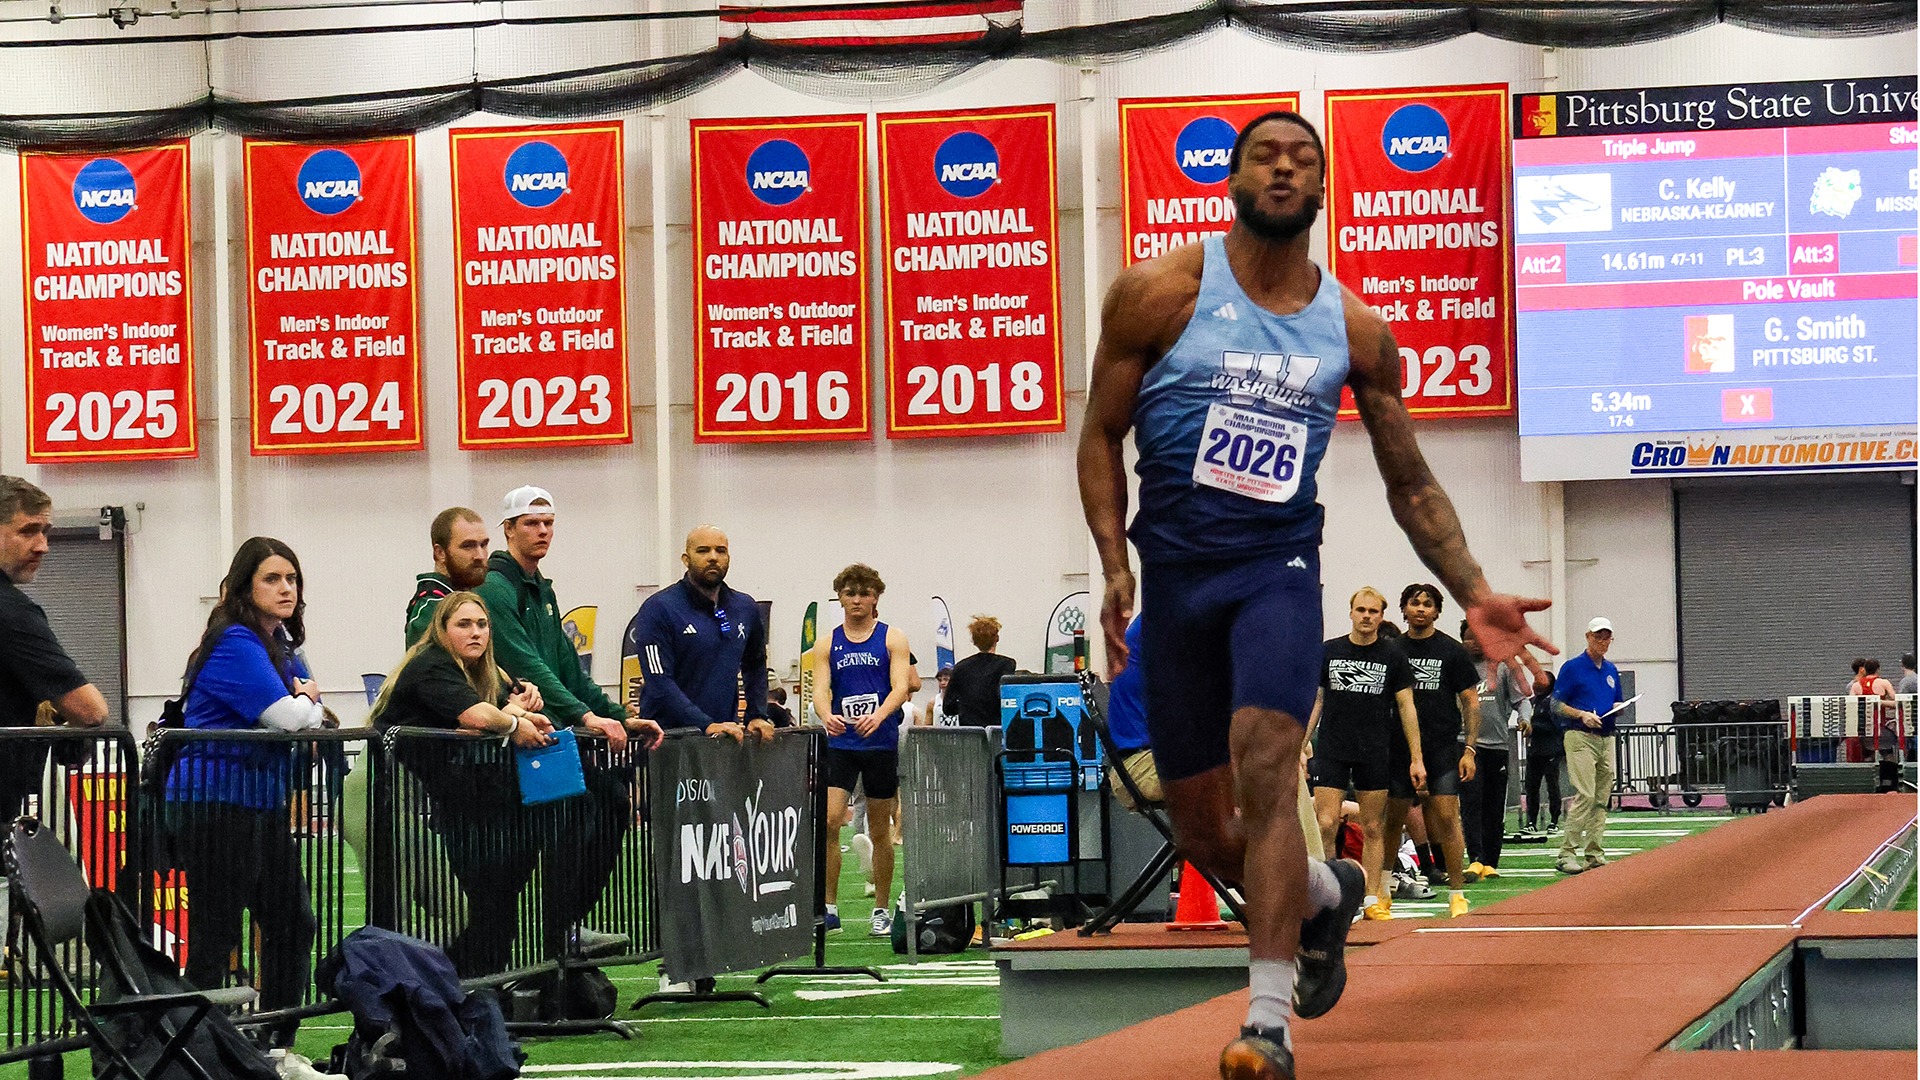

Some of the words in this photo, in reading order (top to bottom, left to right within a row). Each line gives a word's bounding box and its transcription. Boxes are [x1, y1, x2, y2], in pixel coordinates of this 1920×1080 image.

[1566, 93, 1716, 129] Pittsburg
[1727, 87, 1811, 118] State
[1389, 135, 1448, 156] NCAA
[1602, 139, 1647, 159] Triple
[1650, 139, 1696, 157] Jump
[511, 172, 567, 192] NCAA
[752, 169, 809, 190] NCAA
[941, 161, 998, 182] NCAA
[79, 188, 135, 208] NCAA
[304, 180, 359, 198] NCAA
[1658, 179, 1680, 201] C.
[1686, 176, 1736, 200] Kelly
[1353, 188, 1483, 217] NATIONAL
[1621, 200, 1775, 222] NEBRASKA-KEARNEY
[719, 218, 842, 245] NATIONAL
[907, 208, 1033, 238] NATIONAL
[271, 230, 394, 258] NATIONAL
[478, 223, 601, 251] NATIONAL
[1340, 221, 1498, 252] CHAMPIONS
[47, 239, 169, 267] NATIONAL
[706, 251, 856, 279] CHAMPIONS
[895, 240, 1047, 272] CHAMPIONS
[1521, 255, 1562, 273] Att:2
[1602, 252, 1665, 271] 14.61m
[1670, 252, 1703, 266] 47-11
[1726, 248, 1764, 266] PL:3
[1792, 245, 1834, 263] Att:3
[258, 262, 407, 292] CHAMPIONS
[466, 255, 615, 285] CHAMPIONS
[34, 271, 181, 301] CHAMPIONS
[1362, 276, 1415, 294] Men’s
[1420, 274, 1478, 292] Indoor
[1742, 280, 1784, 301] Pole
[1789, 278, 1836, 298] Vault
[708, 303, 783, 320] Women’s
[789, 302, 855, 318] Outdoor
[917, 295, 967, 313] Men’s
[973, 293, 1028, 310] Indoor
[1416, 299, 1434, 320] &
[1441, 296, 1495, 320] Field
[281, 316, 329, 332] Men’s
[335, 314, 389, 330] Indoor
[482, 309, 531, 326] Men’s
[537, 307, 603, 324] Outdoor
[901, 319, 962, 341] Track
[969, 318, 986, 338] &
[993, 314, 1045, 337] Field
[1764, 318, 1789, 342] G.
[1796, 314, 1866, 341] Smith
[42, 324, 118, 341] Women’s
[123, 322, 176, 338] Indoor
[472, 332, 532, 354] Track
[539, 331, 555, 352] &
[563, 328, 613, 350] Field
[711, 327, 771, 348] Track
[777, 326, 794, 346] &
[802, 324, 852, 346] Field
[40, 347, 100, 368] Track
[106, 346, 123, 366] &
[130, 343, 179, 365] Field
[264, 339, 324, 360] Track
[331, 338, 347, 358] &
[355, 335, 405, 357] Field
[1752, 346, 1848, 366] PITTSBURG
[1852, 346, 1878, 363] ST.
[1398, 345, 1492, 398] 023
[716, 371, 849, 421] 2016
[908, 362, 1043, 415] 2018
[1211, 373, 1315, 407] WASHBURN
[270, 382, 403, 433] 2024
[478, 375, 611, 428] 2023
[1590, 391, 1652, 413] 5.34m
[1740, 395, 1754, 415] X
[46, 390, 177, 441] 2025
[1608, 415, 1634, 427] 17-6
[1203, 427, 1297, 482] 2026
[836, 657, 879, 670] KEARNEY
[845, 701, 876, 717] 1827
[1011, 823, 1063, 834] POWERADE
